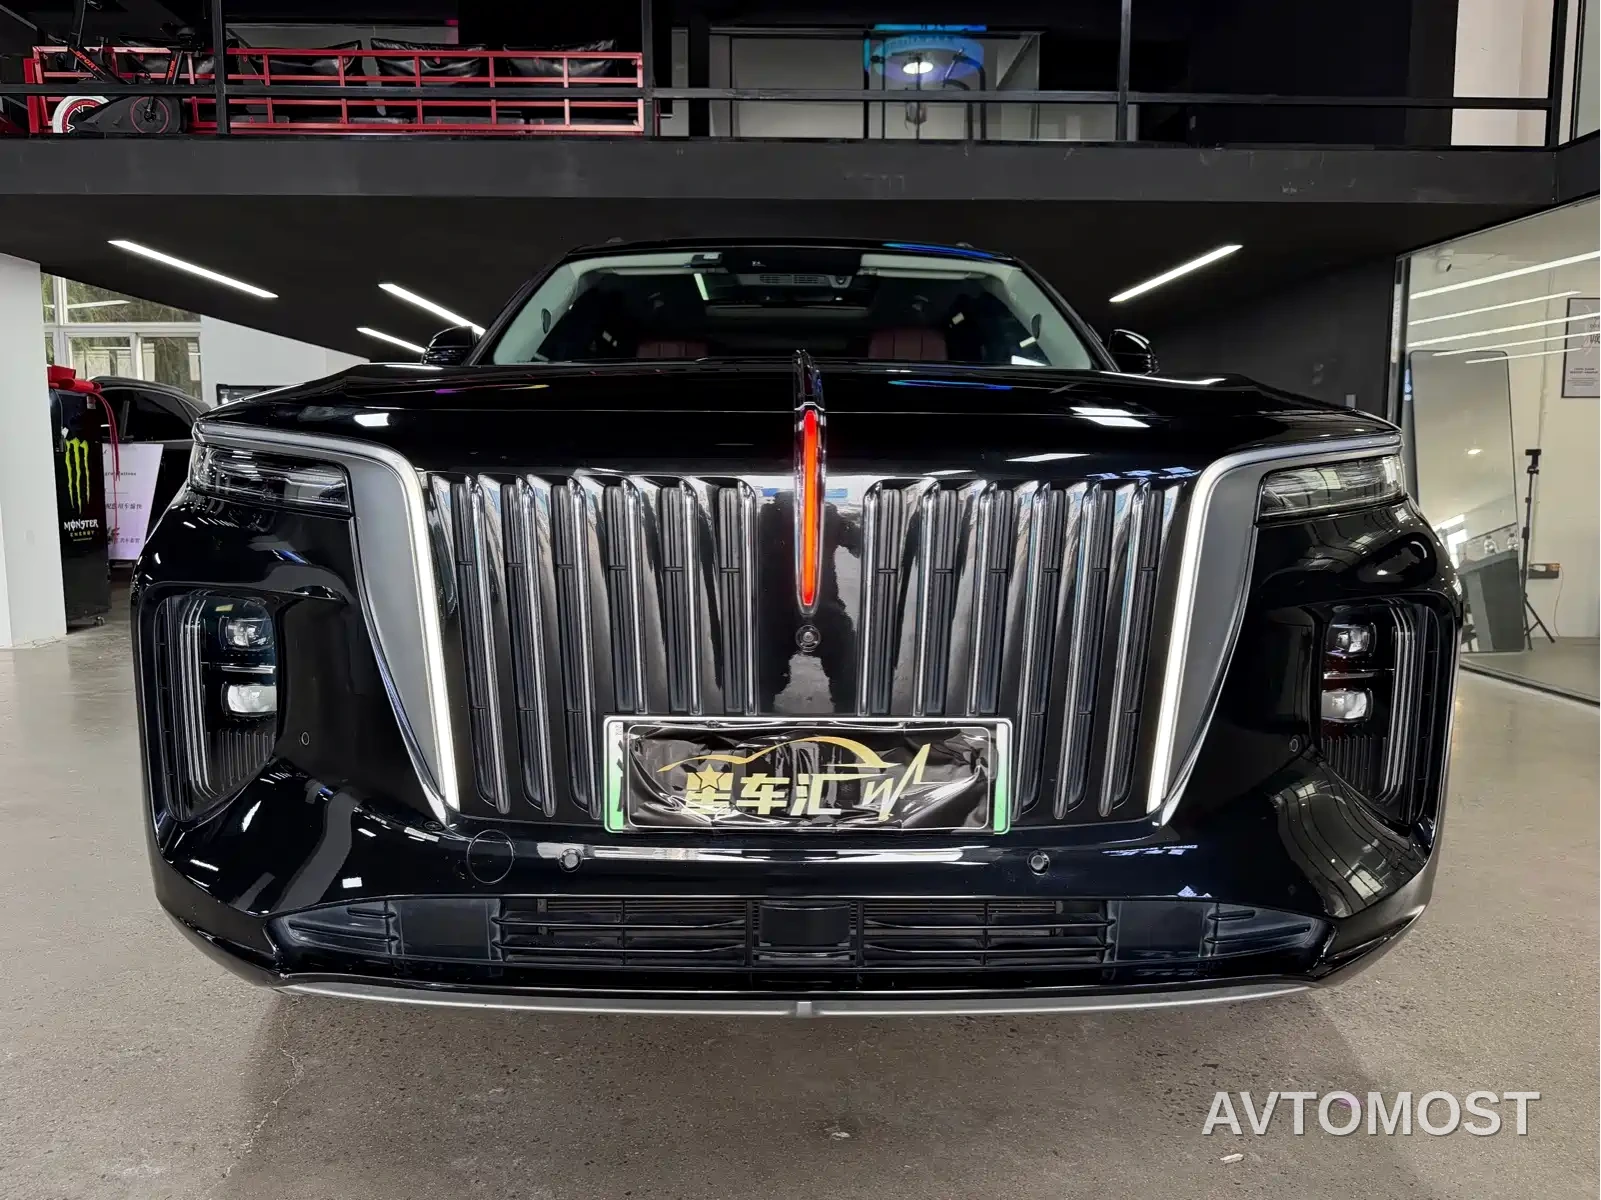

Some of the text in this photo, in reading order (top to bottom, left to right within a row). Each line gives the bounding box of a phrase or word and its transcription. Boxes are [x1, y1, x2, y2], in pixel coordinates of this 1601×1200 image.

[75, 50, 100, 72] SPORT
[64, 518, 98, 531] MONSTER
[70, 530, 95, 538] ENERGY
[680, 764, 872, 817] 星车汇
